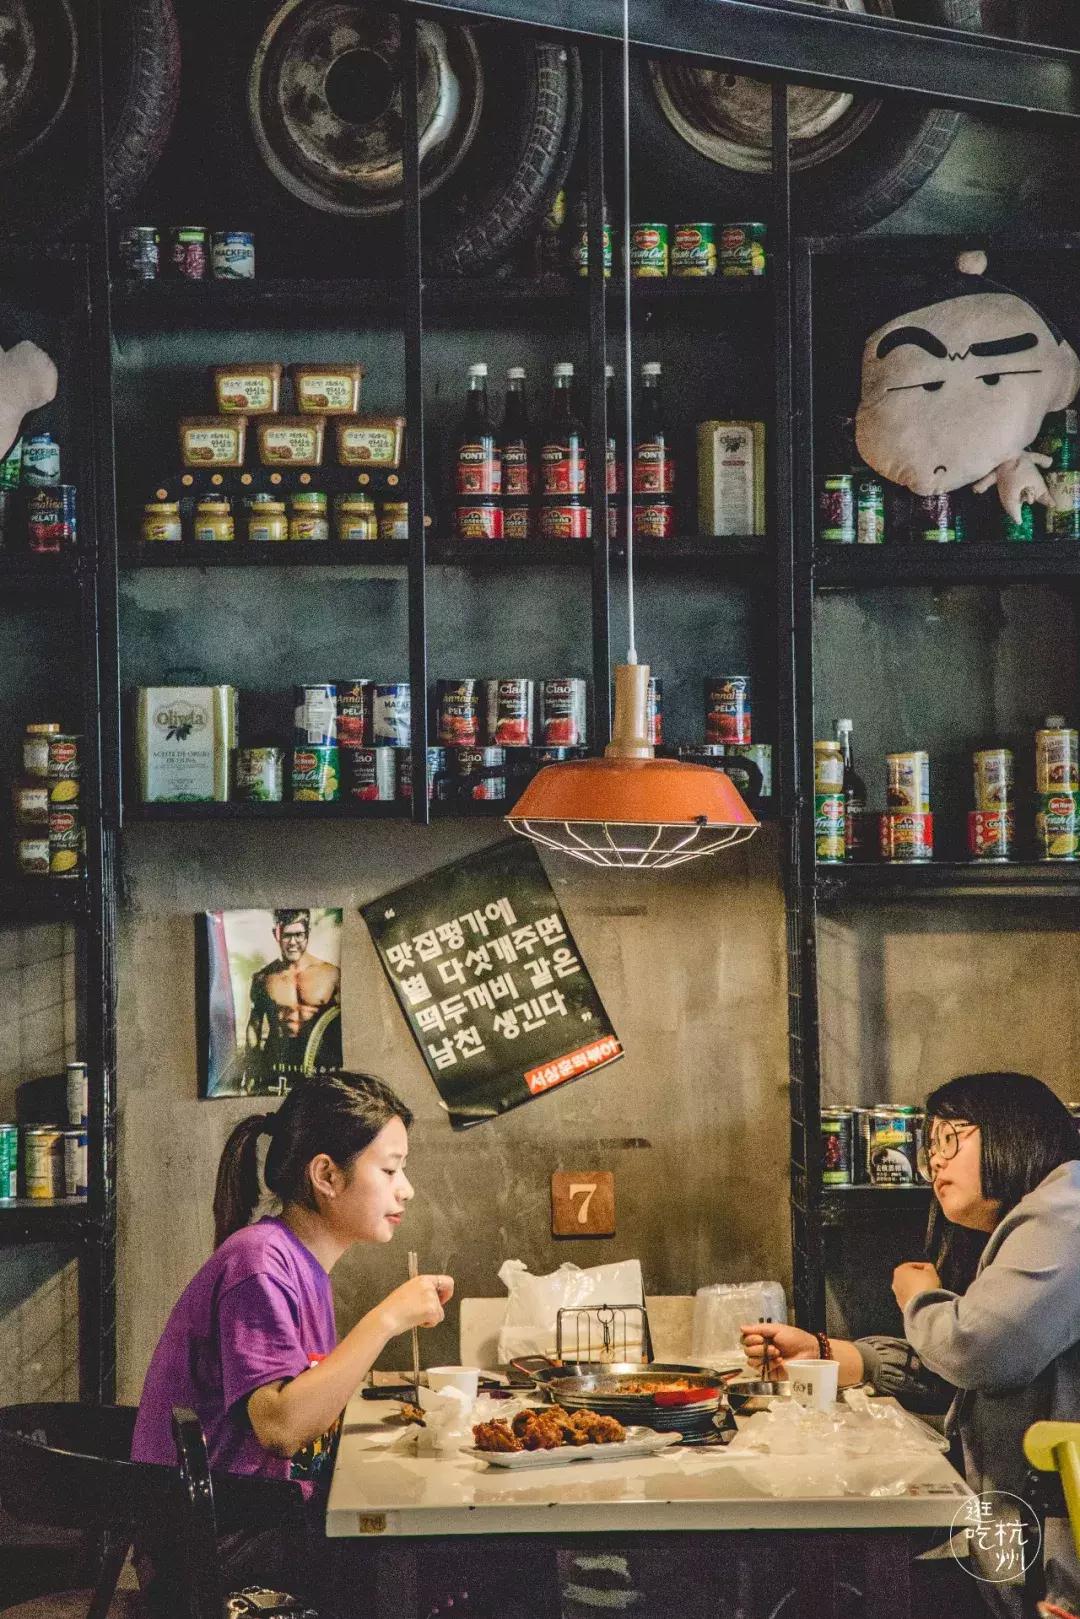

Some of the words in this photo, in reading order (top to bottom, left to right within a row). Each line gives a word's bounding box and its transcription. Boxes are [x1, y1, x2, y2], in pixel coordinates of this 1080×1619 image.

[545, 685, 571, 694] Ciao
[386, 897, 517, 972] 맛집평가에
[400, 973, 432, 1005] 별
[437, 914, 566, 984] 다섯개주면
[415, 973, 519, 1033] 떡두꺼비
[524, 947, 581, 989] 같은
[428, 1026, 485, 1070] 남친
[493, 989, 568, 1039] 생긴다
[569, 1183, 598, 1224] 7
